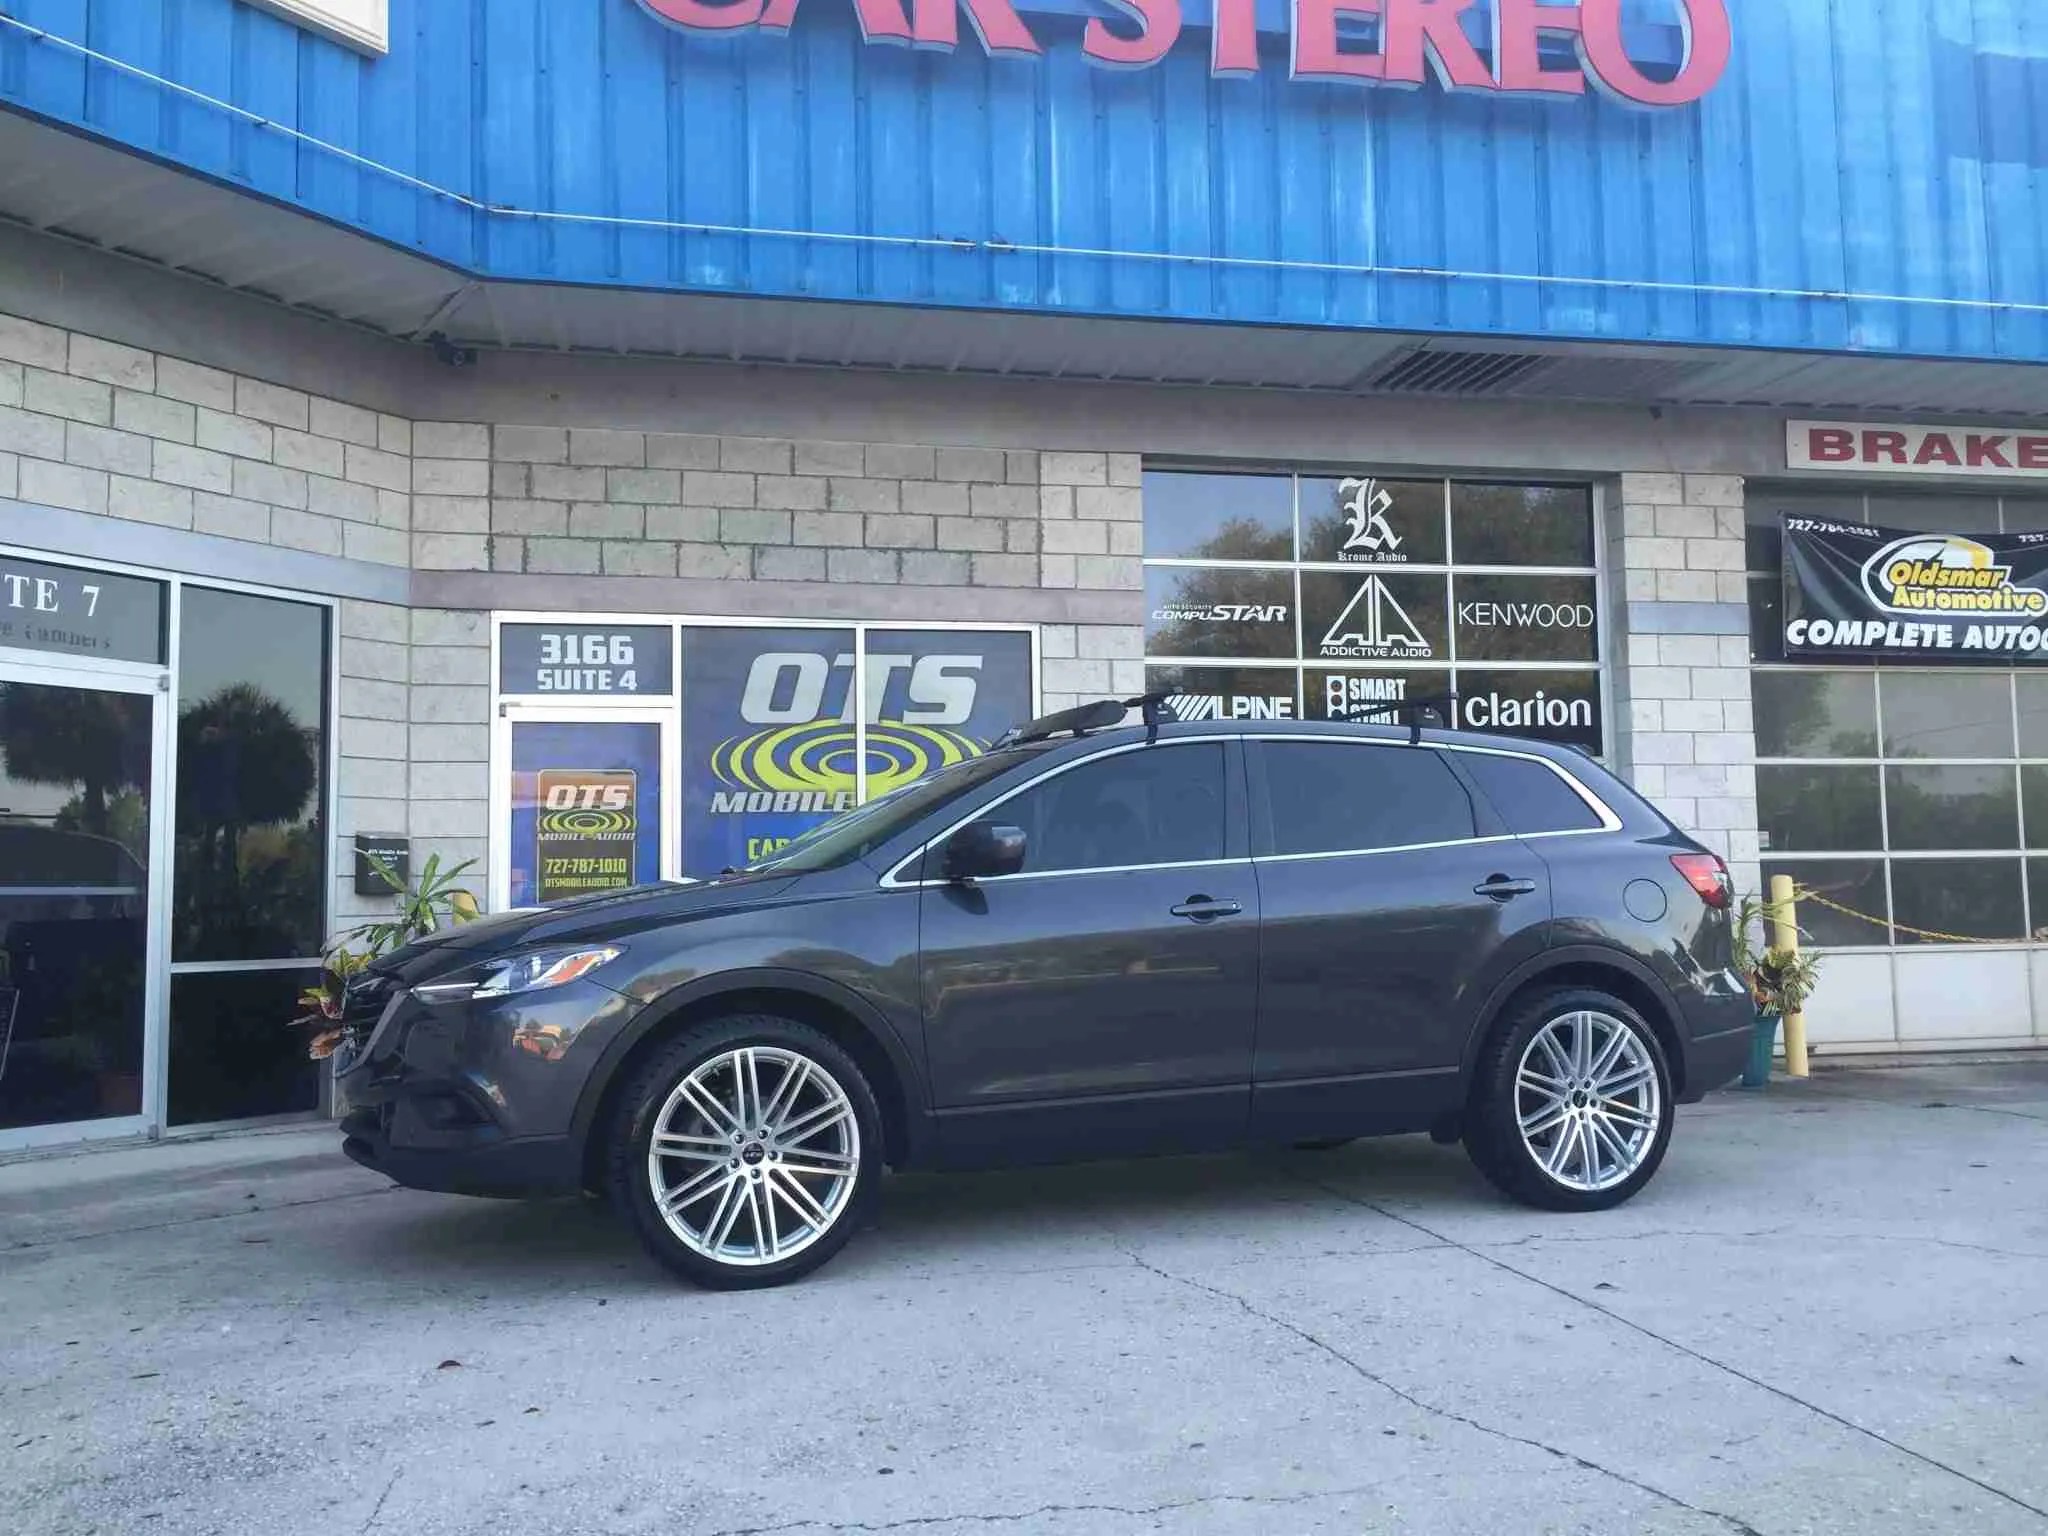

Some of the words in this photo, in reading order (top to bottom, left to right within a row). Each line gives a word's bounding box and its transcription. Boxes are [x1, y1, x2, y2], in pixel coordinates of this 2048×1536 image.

[1376, 551, 1407, 561] Audio
[1889, 560, 2004, 588] Oldsmar
[82, 584, 100, 616] 7
[1892, 586, 2045, 611] Automotive
[1459, 602, 1594, 628] KENWOOD
[1786, 619, 1952, 648] COMPLETE
[540, 634, 634, 665] 3166
[1320, 647, 1388, 656] ADDICTIVE
[1391, 648, 1432, 657] AUDIO
[537, 669, 612, 690] SUITE
[619, 670, 638, 691] 4
[740, 652, 984, 725] OTS
[1349, 678, 1406, 700] SMART
[1192, 695, 1293, 721] ALPINE
[546, 785, 629, 810] OTS
[710, 791, 857, 813] MOBILE
[545, 858, 627, 874] 727-787-1010
